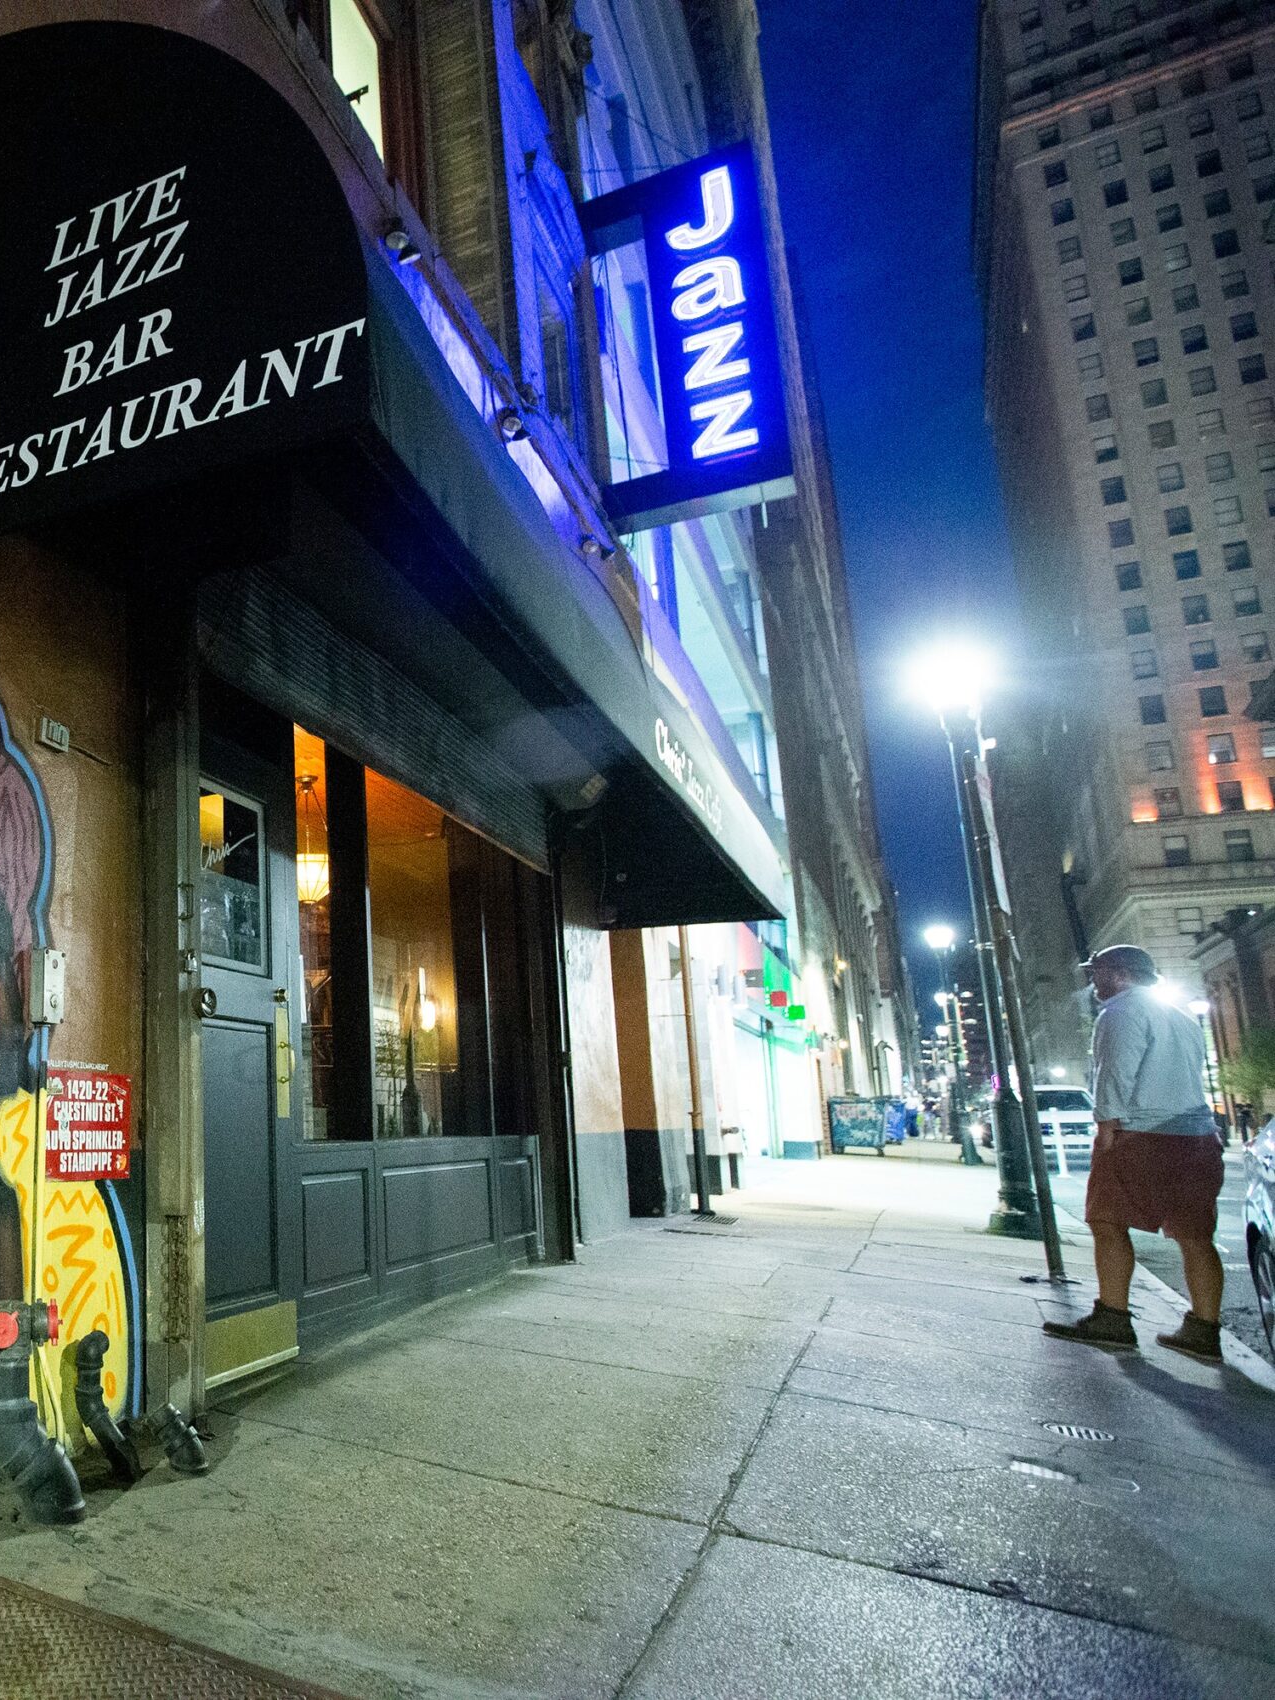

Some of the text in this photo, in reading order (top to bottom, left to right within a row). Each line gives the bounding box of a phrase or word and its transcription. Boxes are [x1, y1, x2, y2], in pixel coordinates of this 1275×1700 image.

[44, 165, 187, 272] LIVE
[43, 220, 189, 328] JAZZ
[665, 165, 759, 459] Jazz
[53, 308, 174, 397] BAR
[53, 1101, 119, 1122] CHESTNUT ST.
[67, 1079, 109, 1100] 1420-22
[59, 1152, 113, 1173] STANDPIPE
